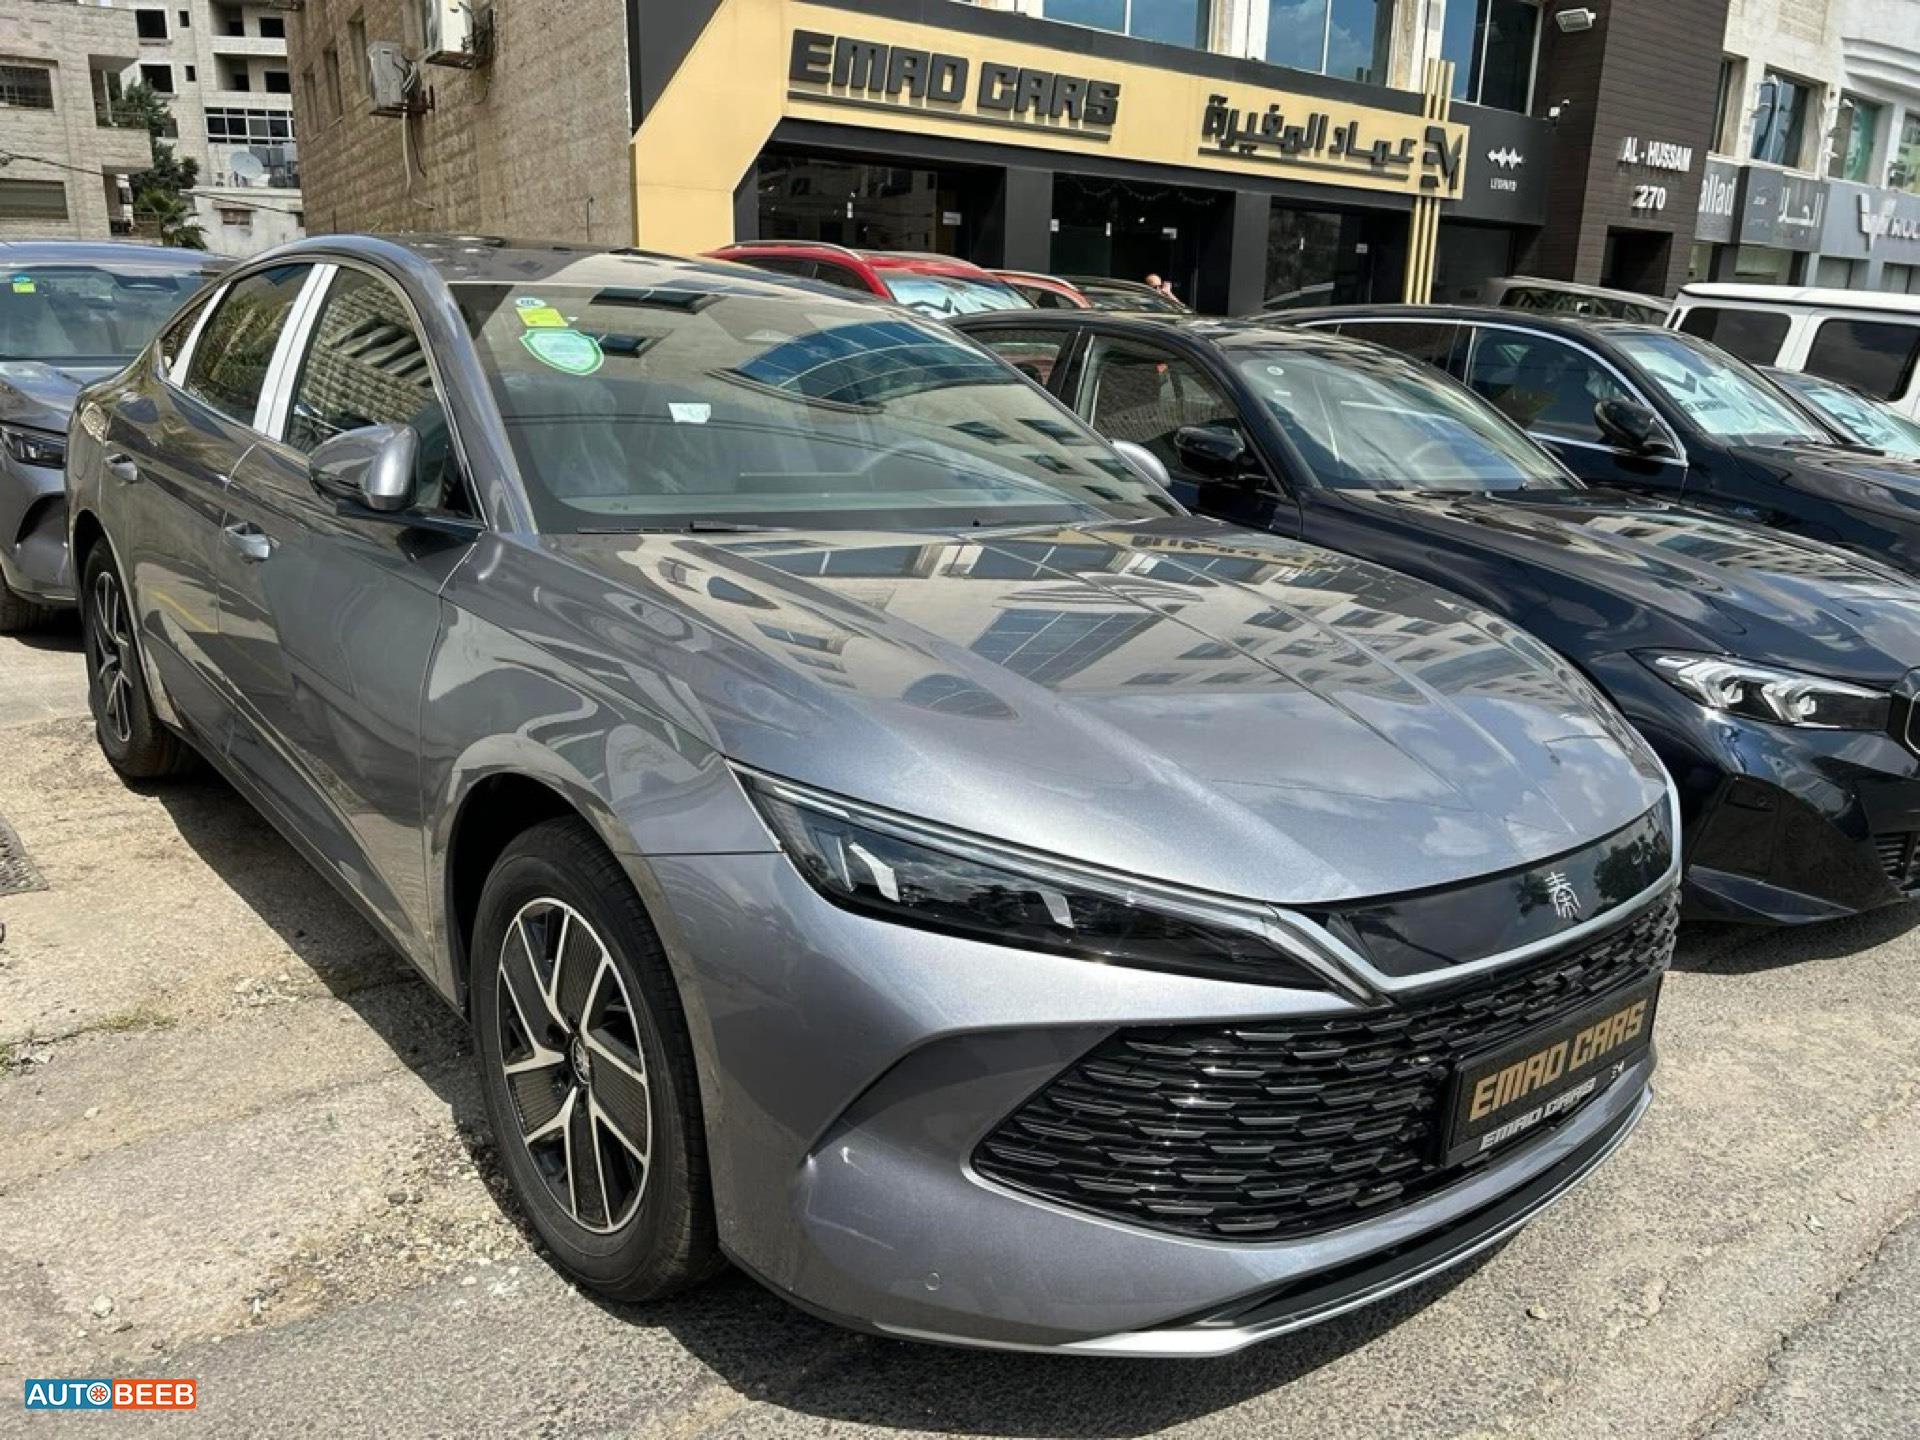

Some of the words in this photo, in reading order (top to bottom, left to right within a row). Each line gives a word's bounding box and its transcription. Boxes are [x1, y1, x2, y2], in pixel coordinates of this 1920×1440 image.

[789, 28, 968, 103] EMAD
[976, 61, 1121, 125] CARS
[1201, 93, 1329, 155] المغيرة
[1329, 120, 1417, 166] عماد
[1632, 184, 1666, 211] 270
[1469, 1039, 1569, 1122] EMAD
[1569, 1000, 1647, 1072] CARS
